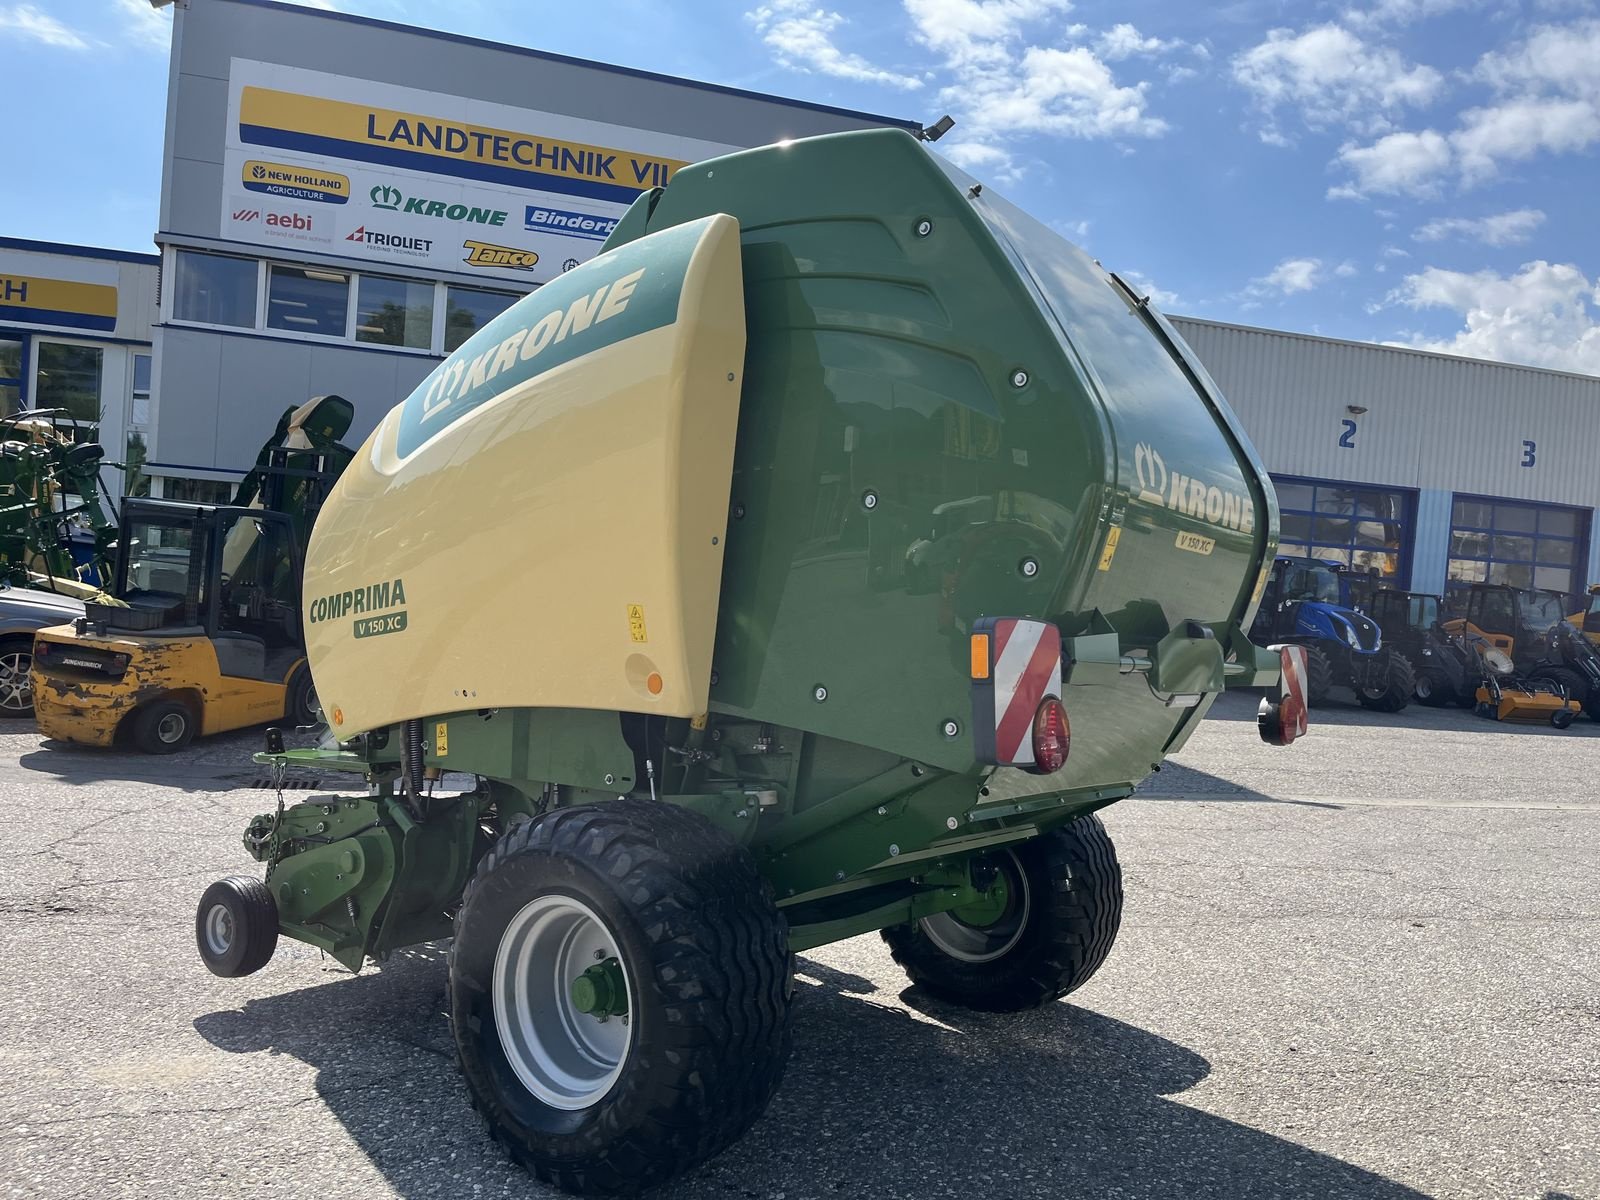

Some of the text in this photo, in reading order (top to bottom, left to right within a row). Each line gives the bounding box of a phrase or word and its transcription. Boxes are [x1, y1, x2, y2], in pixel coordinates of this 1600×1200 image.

[367, 113, 617, 180] LANDTECHNIK
[268, 170, 342, 190] NEW HOLLAND
[266, 185, 325, 201] AGRICULTURE
[266, 213, 312, 231] aebi
[402, 197, 508, 227] KRONE
[365, 231, 433, 252] TRIOLIET
[366, 244, 430, 259] FEEDING TECHNOLOGY
[464, 240, 540, 271] Tanco
[0, 279, 28, 302] H
[456, 267, 647, 400] KRONE
[1338, 419, 1357, 449] 2
[1520, 440, 1536, 468] 3
[1167, 471, 1255, 534] KRONE
[1180, 534, 1211, 552] V 150 XC
[310, 579, 406, 624] COMPRIMA
[359, 616, 401, 635] V 150 XC
